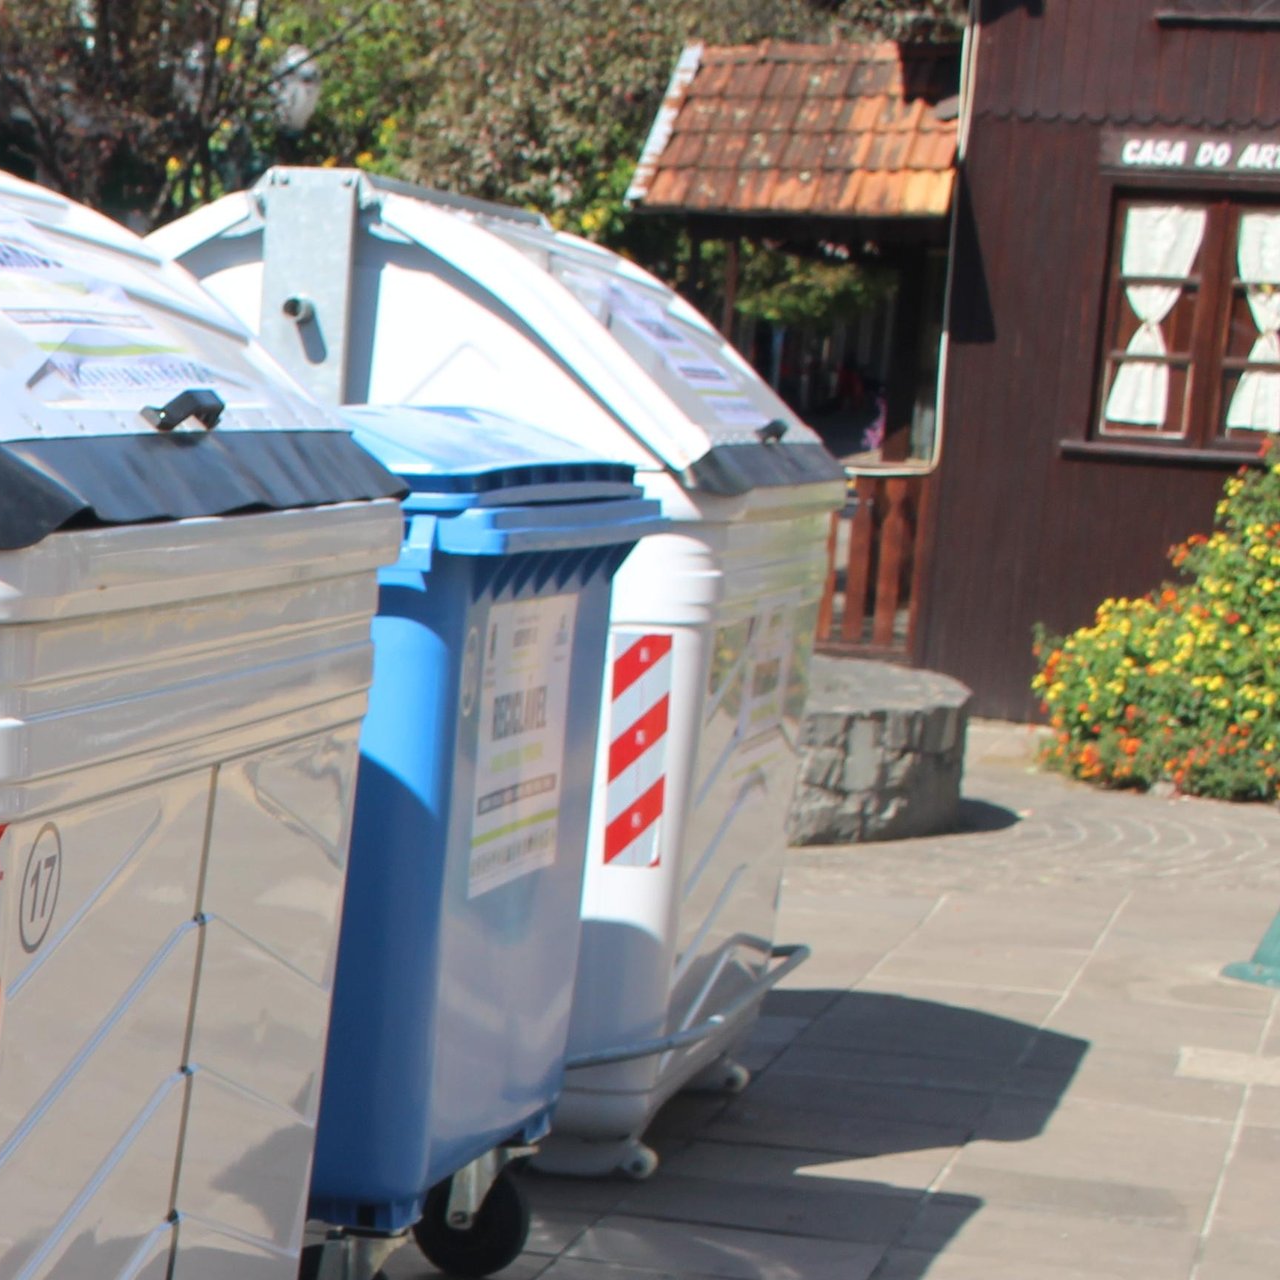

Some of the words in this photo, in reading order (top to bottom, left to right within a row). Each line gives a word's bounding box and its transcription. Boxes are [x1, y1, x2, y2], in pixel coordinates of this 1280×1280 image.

[1122, 138, 1187, 167] CASA
[1195, 141, 1233, 168] DO
[30, 854, 57, 923] 17
